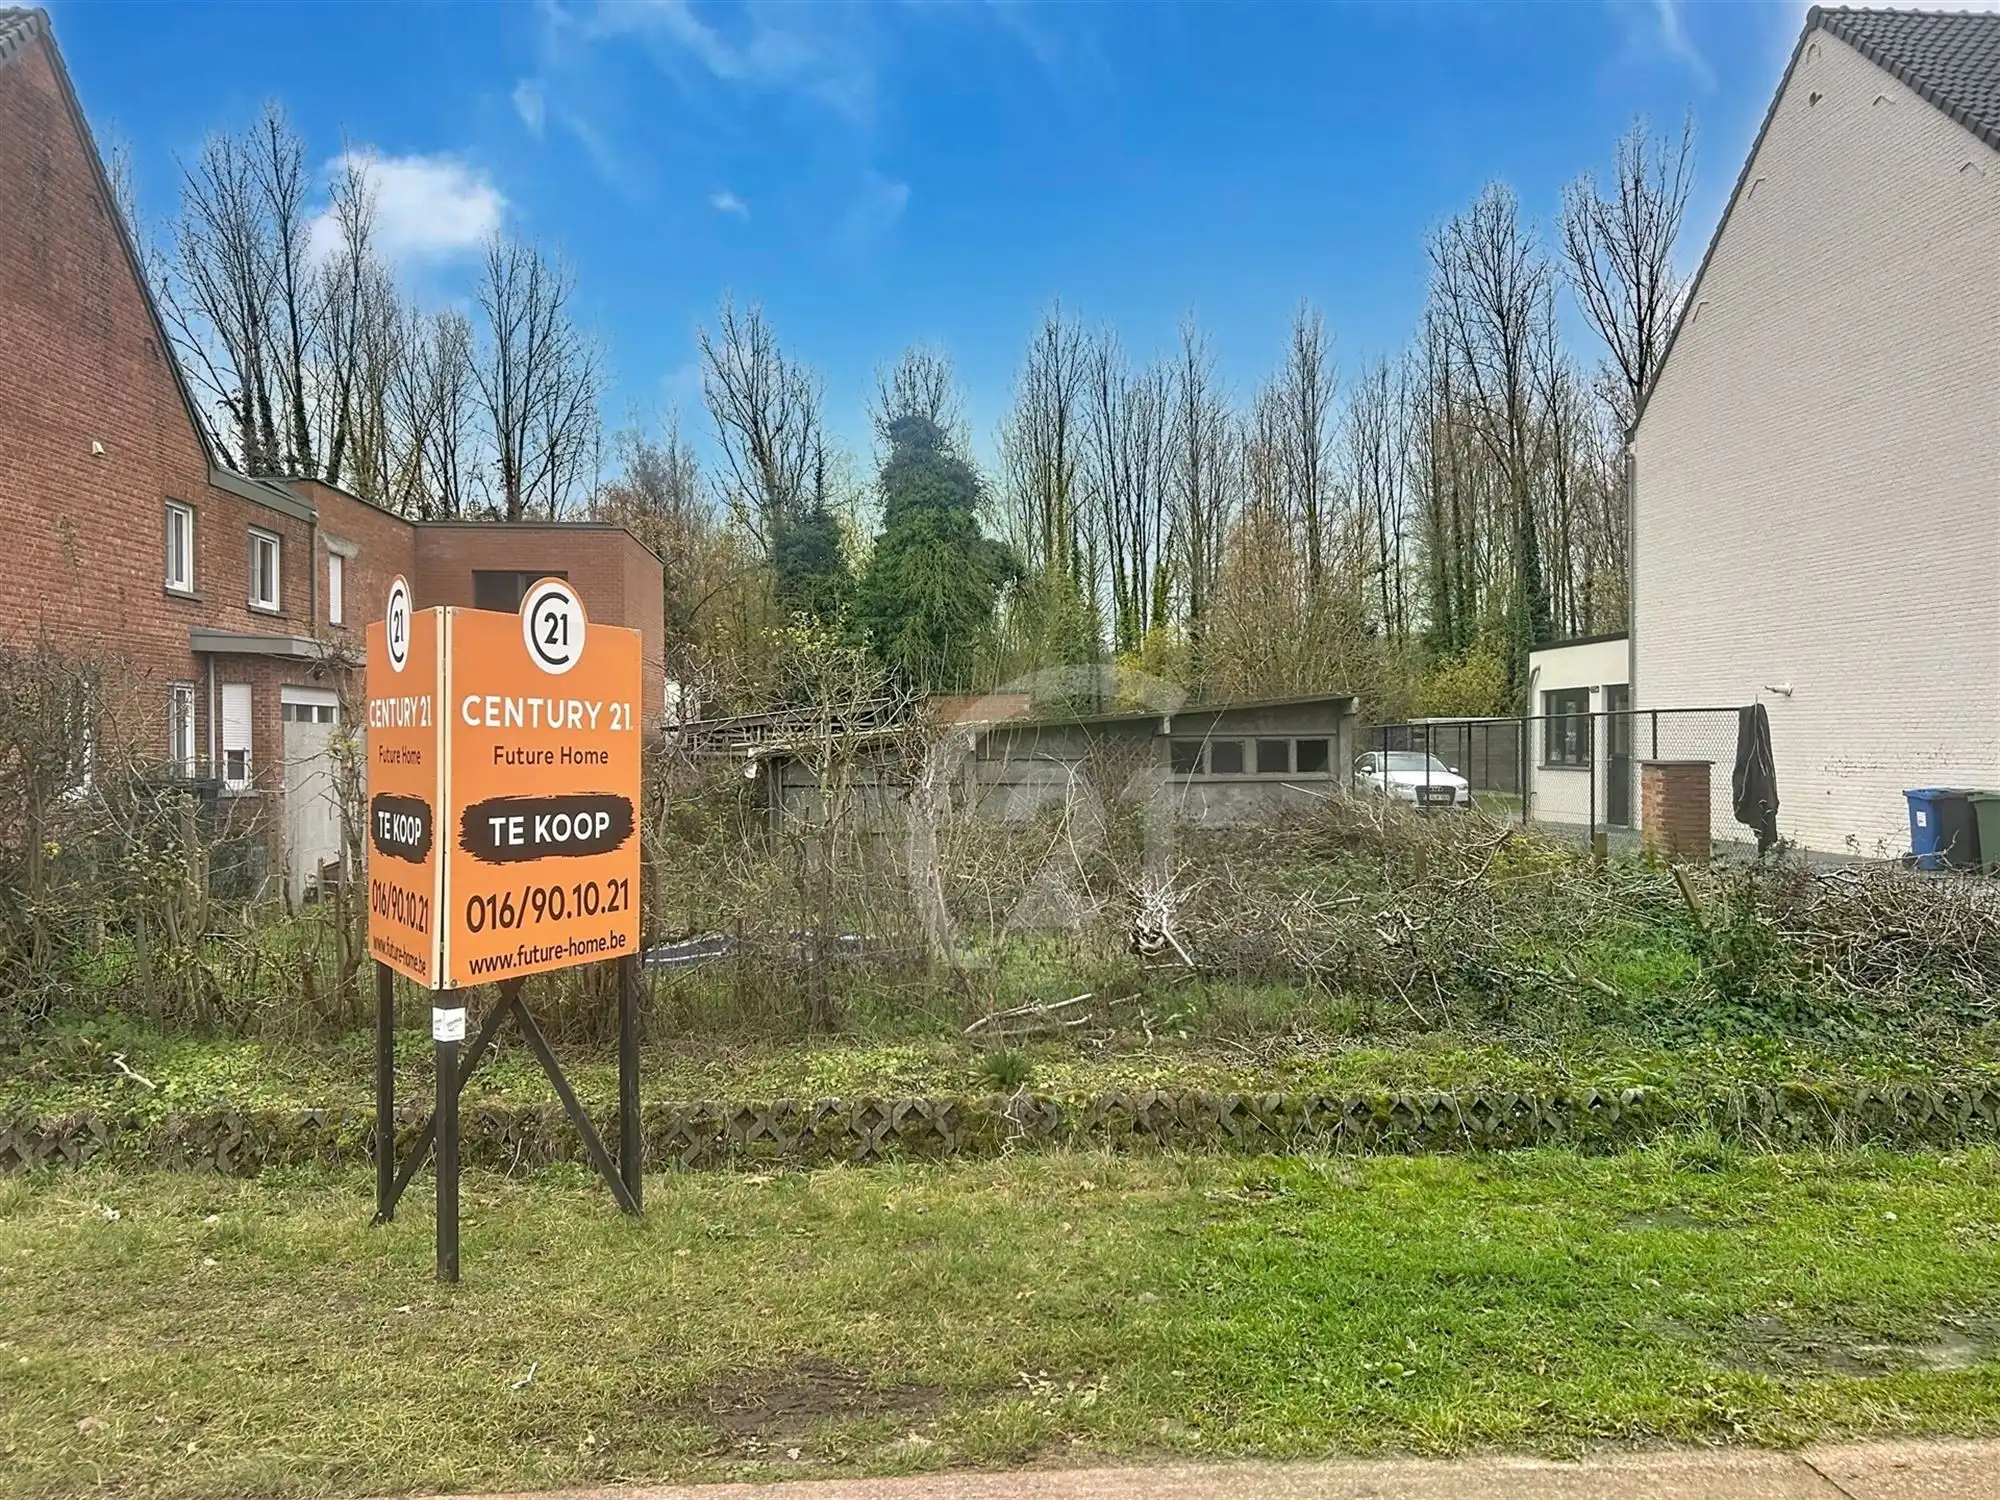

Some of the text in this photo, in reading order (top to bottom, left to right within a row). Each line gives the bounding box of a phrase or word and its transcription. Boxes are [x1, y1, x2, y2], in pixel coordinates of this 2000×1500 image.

[544, 611, 569, 646] 21
[369, 696, 418, 728] CENTURY
[461, 694, 603, 730] CENTURY
[378, 745, 421, 765] Future Home
[494, 746, 609, 765] Future Home
[378, 810, 422, 847] TE KOOP
[488, 811, 610, 847] TE KOOP
[372, 878, 429, 935] 016/90.10.21
[466, 878, 629, 934] 016/90.10.21
[372, 935, 427, 977] www.future-home.be
[469, 930, 626, 975] www.future-home.be
